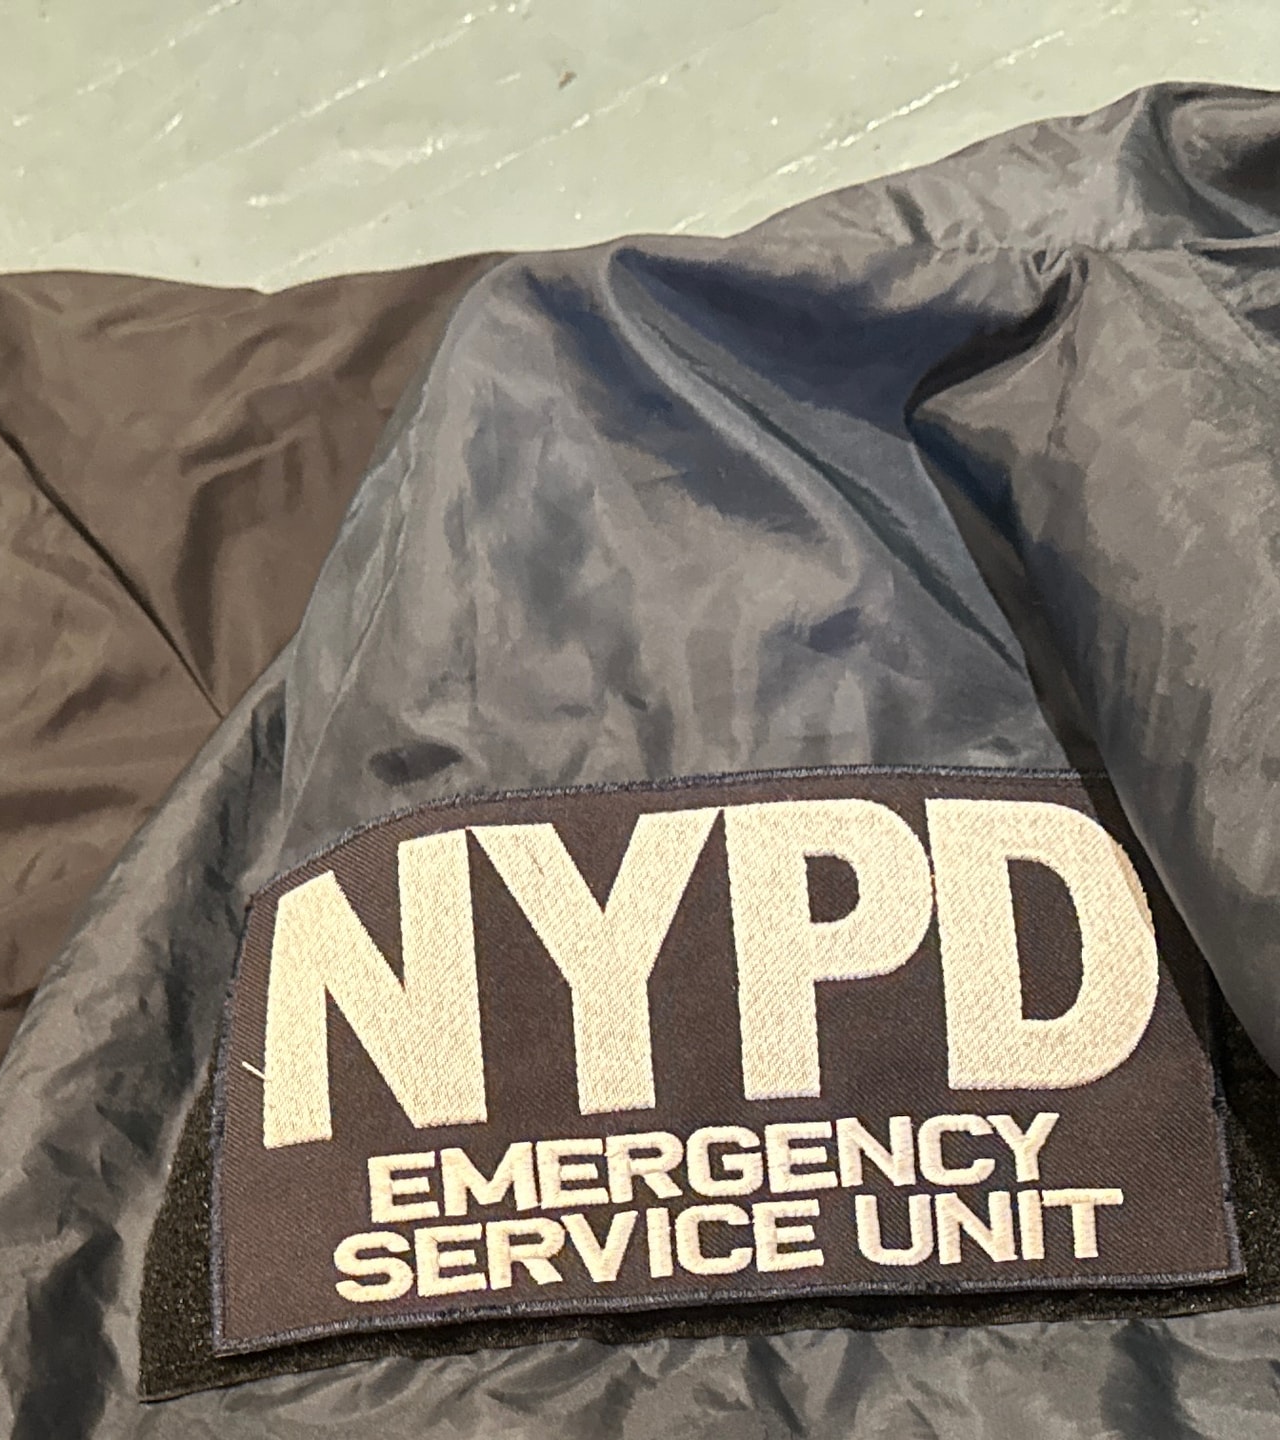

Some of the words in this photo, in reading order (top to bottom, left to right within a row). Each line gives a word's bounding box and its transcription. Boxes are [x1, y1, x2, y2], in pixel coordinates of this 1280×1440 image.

[263, 797, 1160, 1149] NYPD
[366, 1112, 1060, 1225] EMERGENCY
[332, 1199, 824, 1304] SERVICE
[853, 1187, 1124, 1267] UNIT
